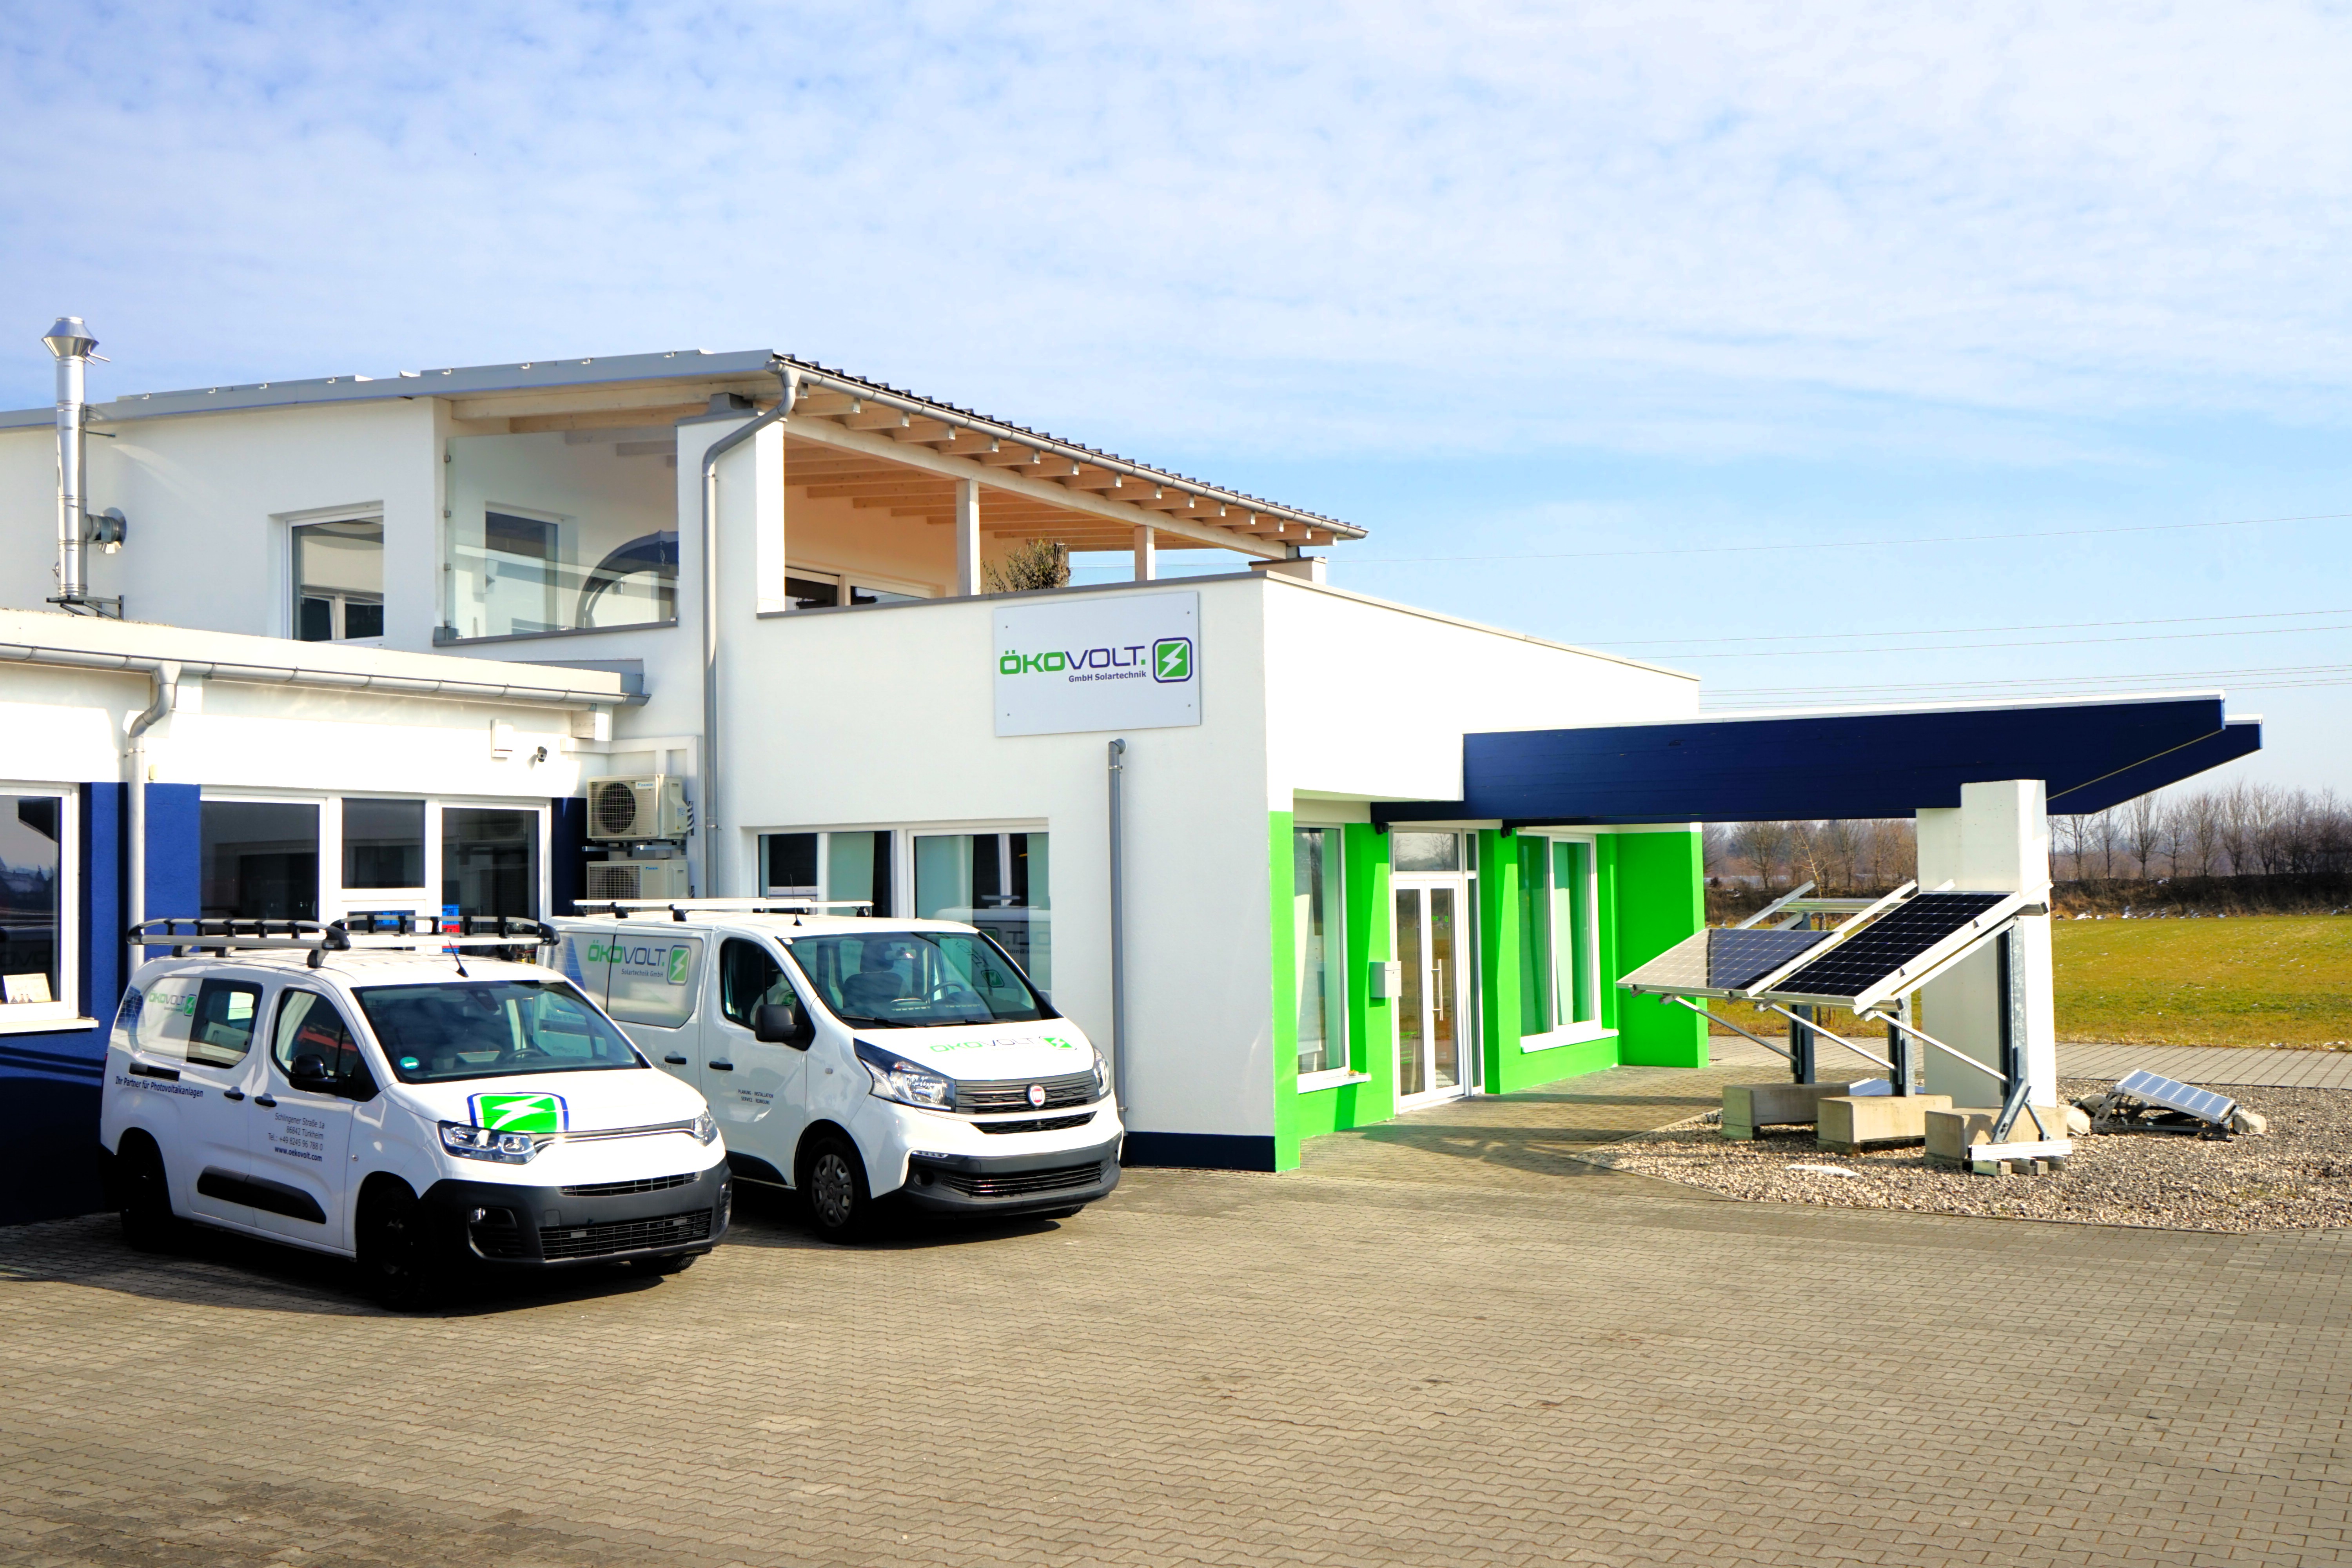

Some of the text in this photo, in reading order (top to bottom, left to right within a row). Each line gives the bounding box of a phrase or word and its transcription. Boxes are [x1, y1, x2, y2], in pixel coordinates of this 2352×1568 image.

[1069, 670, 1147, 682] GmbH Solartechnik
[123, 1077, 141, 1088] Partner
[150, 1082, 203, 1098] Photovoltaikanlagen
[275, 1112, 301, 1124] Schlingener
[302, 1118, 318, 1127] Straße
[286, 1125, 324, 1140] 86842 Türkheim
[290, 1137, 301, 1146] 8245
[275, 1146, 322, 1162] www.oekovolt.com
